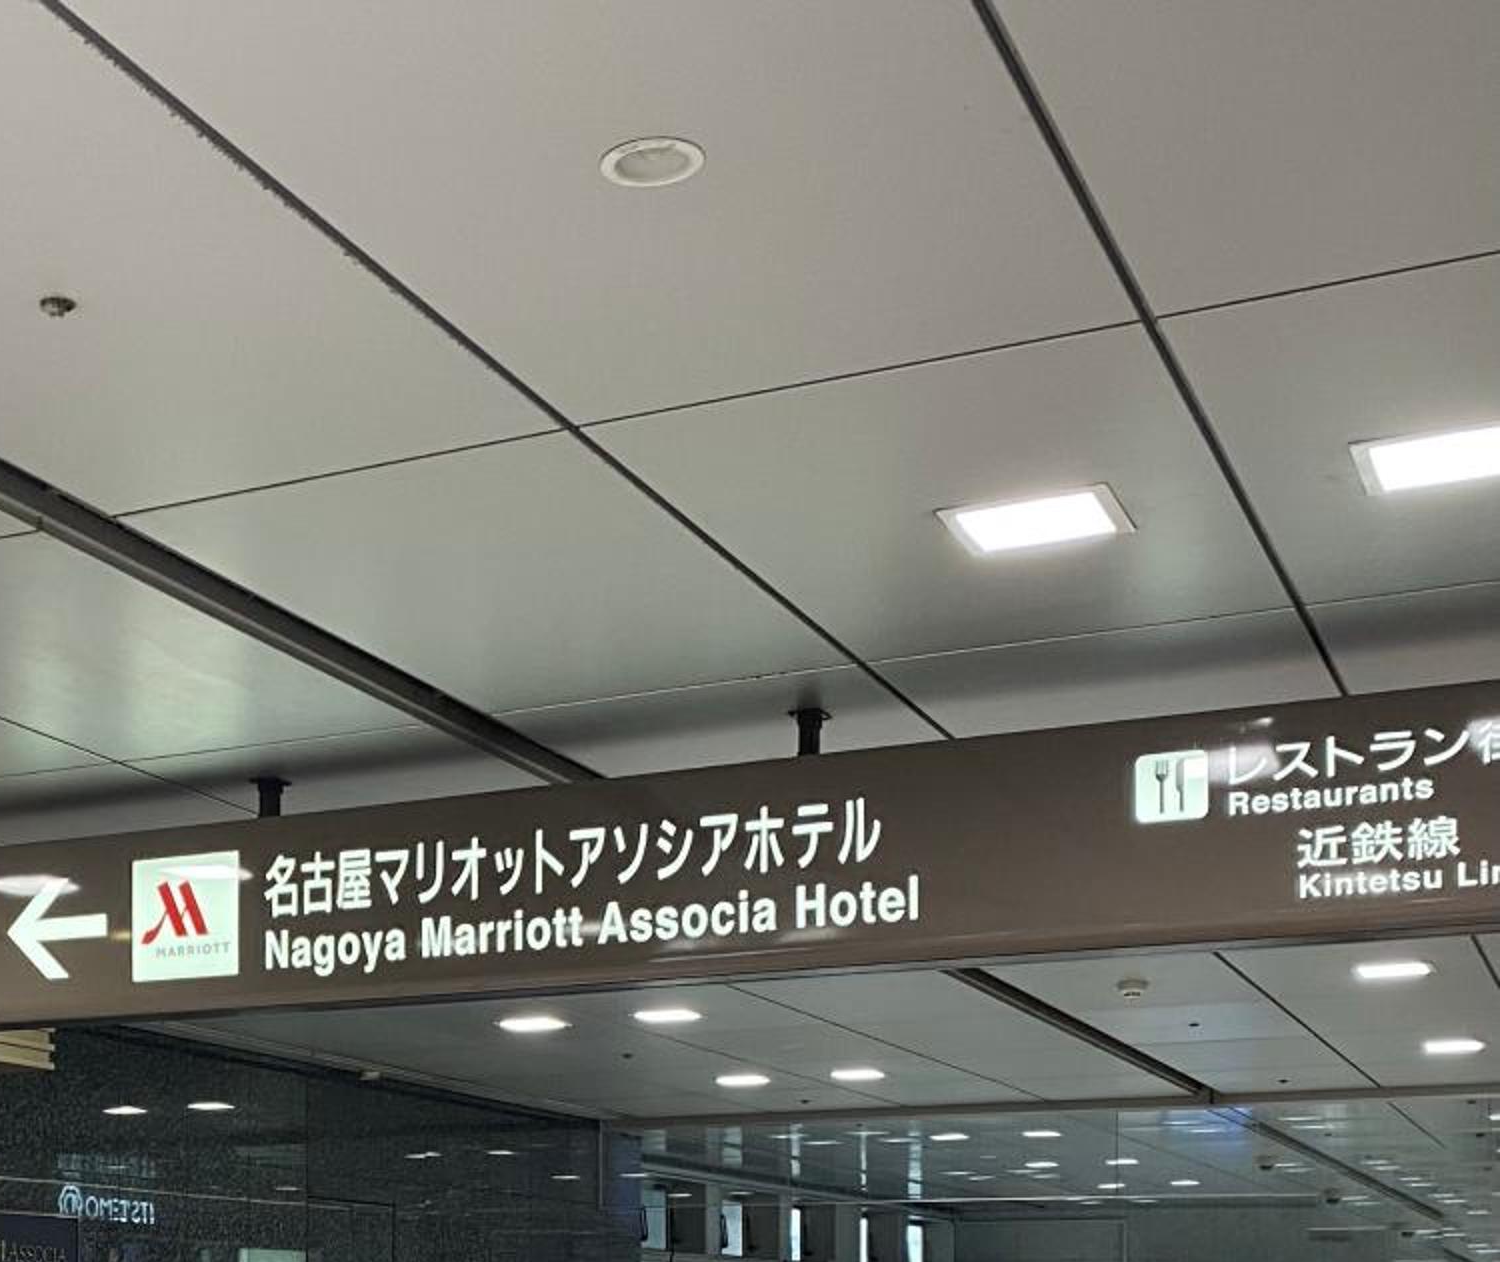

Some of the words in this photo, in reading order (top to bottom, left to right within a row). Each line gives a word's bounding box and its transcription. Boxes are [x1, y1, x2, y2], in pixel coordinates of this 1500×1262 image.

[1228, 776, 1435, 817] Restaurants
[264, 797, 882, 919] 名古屋マリオットアソシアホテル
[1296, 815, 1461, 868] 近鉄線
[1299, 866, 1444, 900] Kintetsu
[265, 927, 407, 977] Nagoya
[420, 906, 584, 958] Marriott
[597, 888, 778, 945] Associa
[795, 873, 919, 929] Hotel
[156, 941, 231, 958] MARRIOTT
